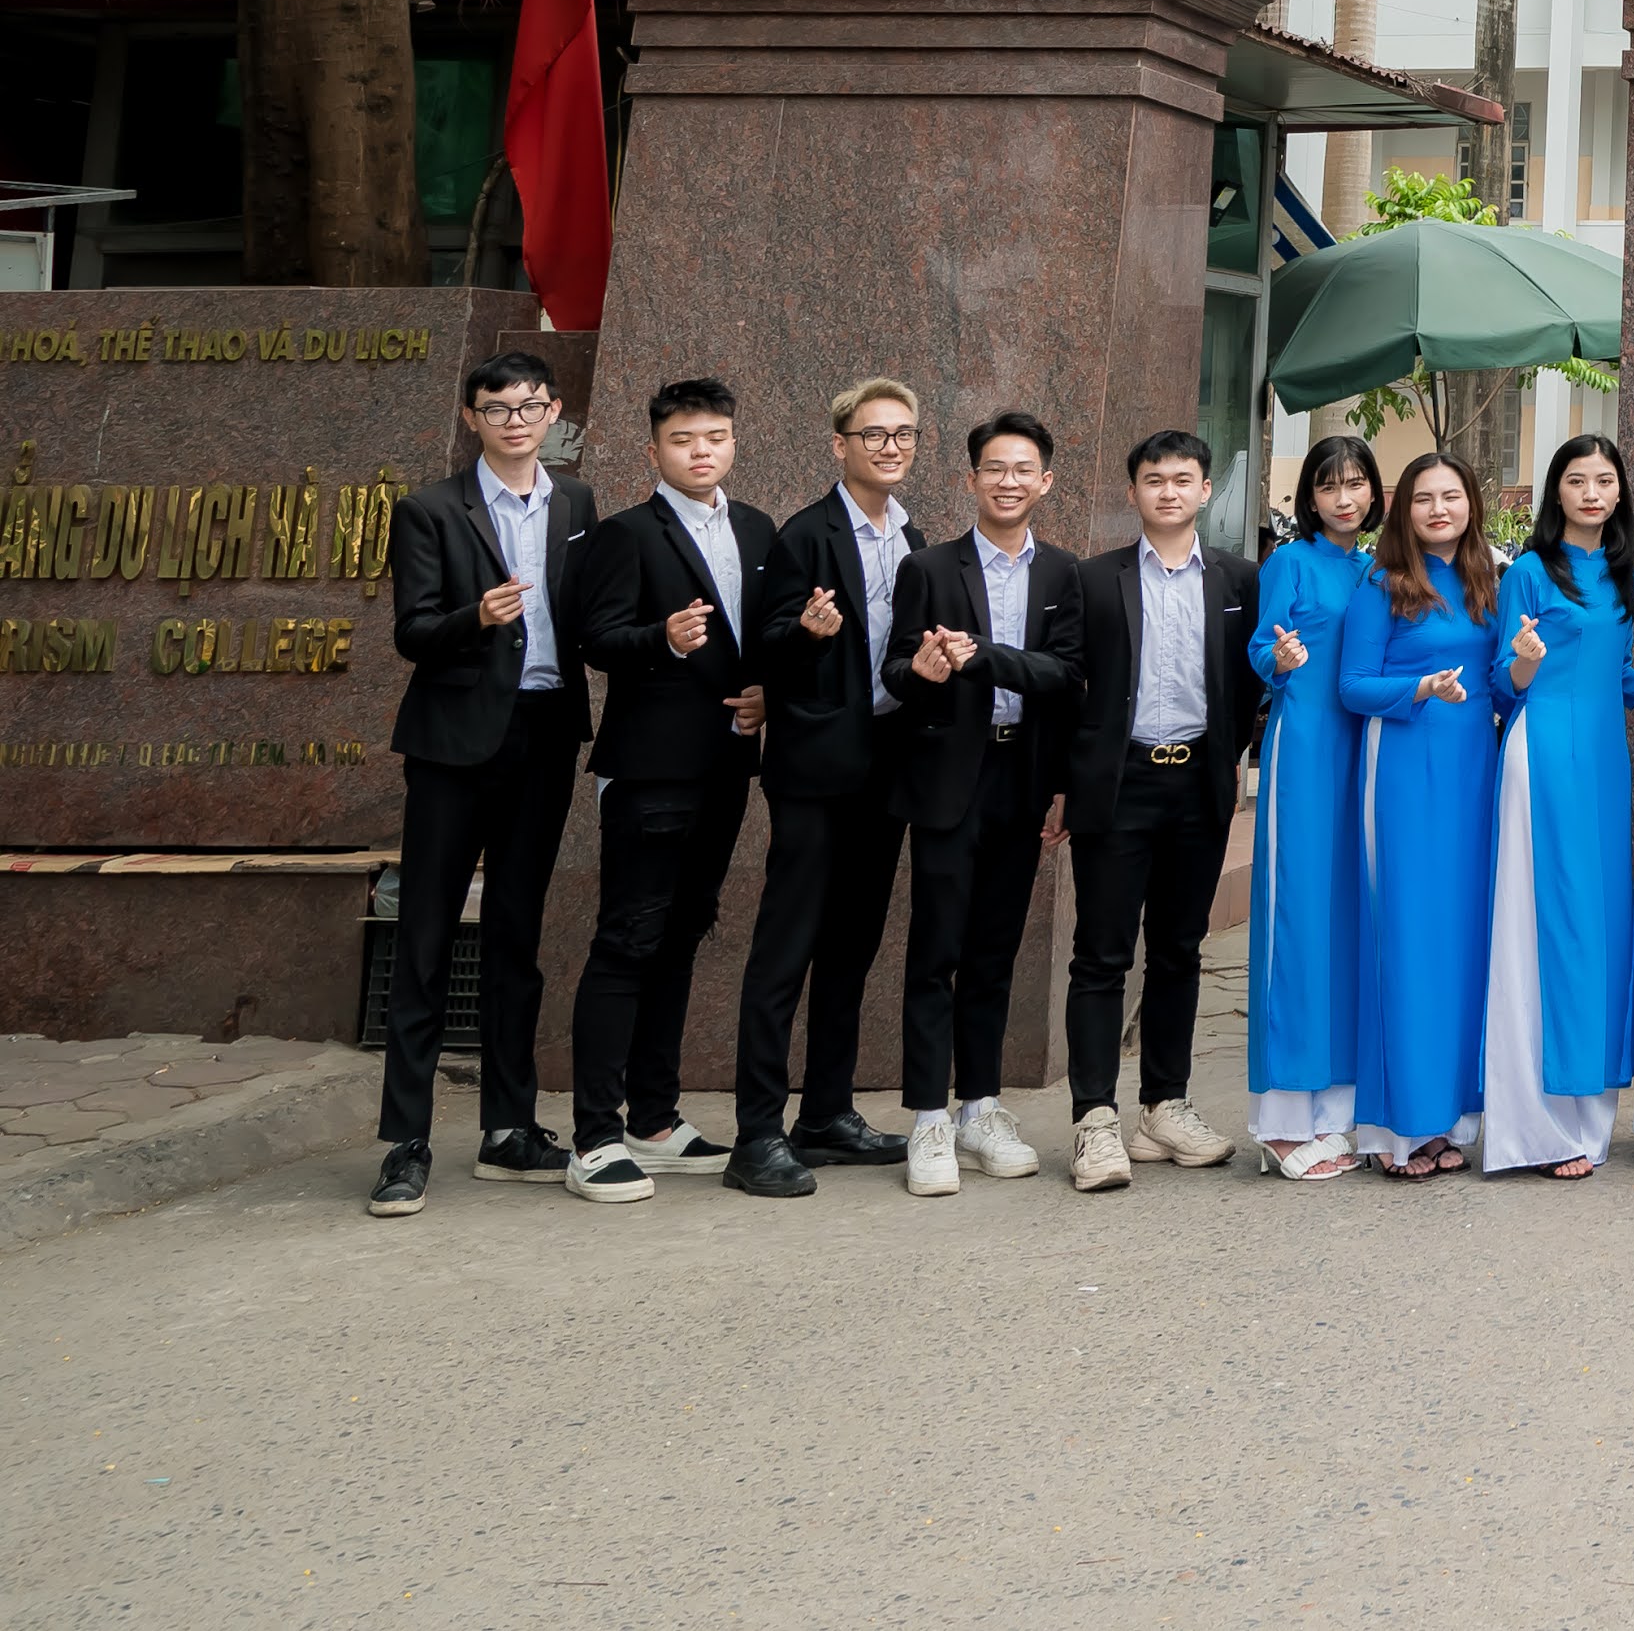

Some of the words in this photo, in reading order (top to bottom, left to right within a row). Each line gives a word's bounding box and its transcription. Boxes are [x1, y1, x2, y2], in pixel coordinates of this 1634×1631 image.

[10, 319, 88, 367] HOÁ,
[163, 328, 247, 361] THAO
[258, 320, 295, 361] VÀ
[303, 327, 348, 361] DU
[90, 484, 156, 581] DU
[157, 484, 259, 598] LỊCH
[263, 465, 321, 580] HÀ
[152, 617, 355, 677] COLLEGE
